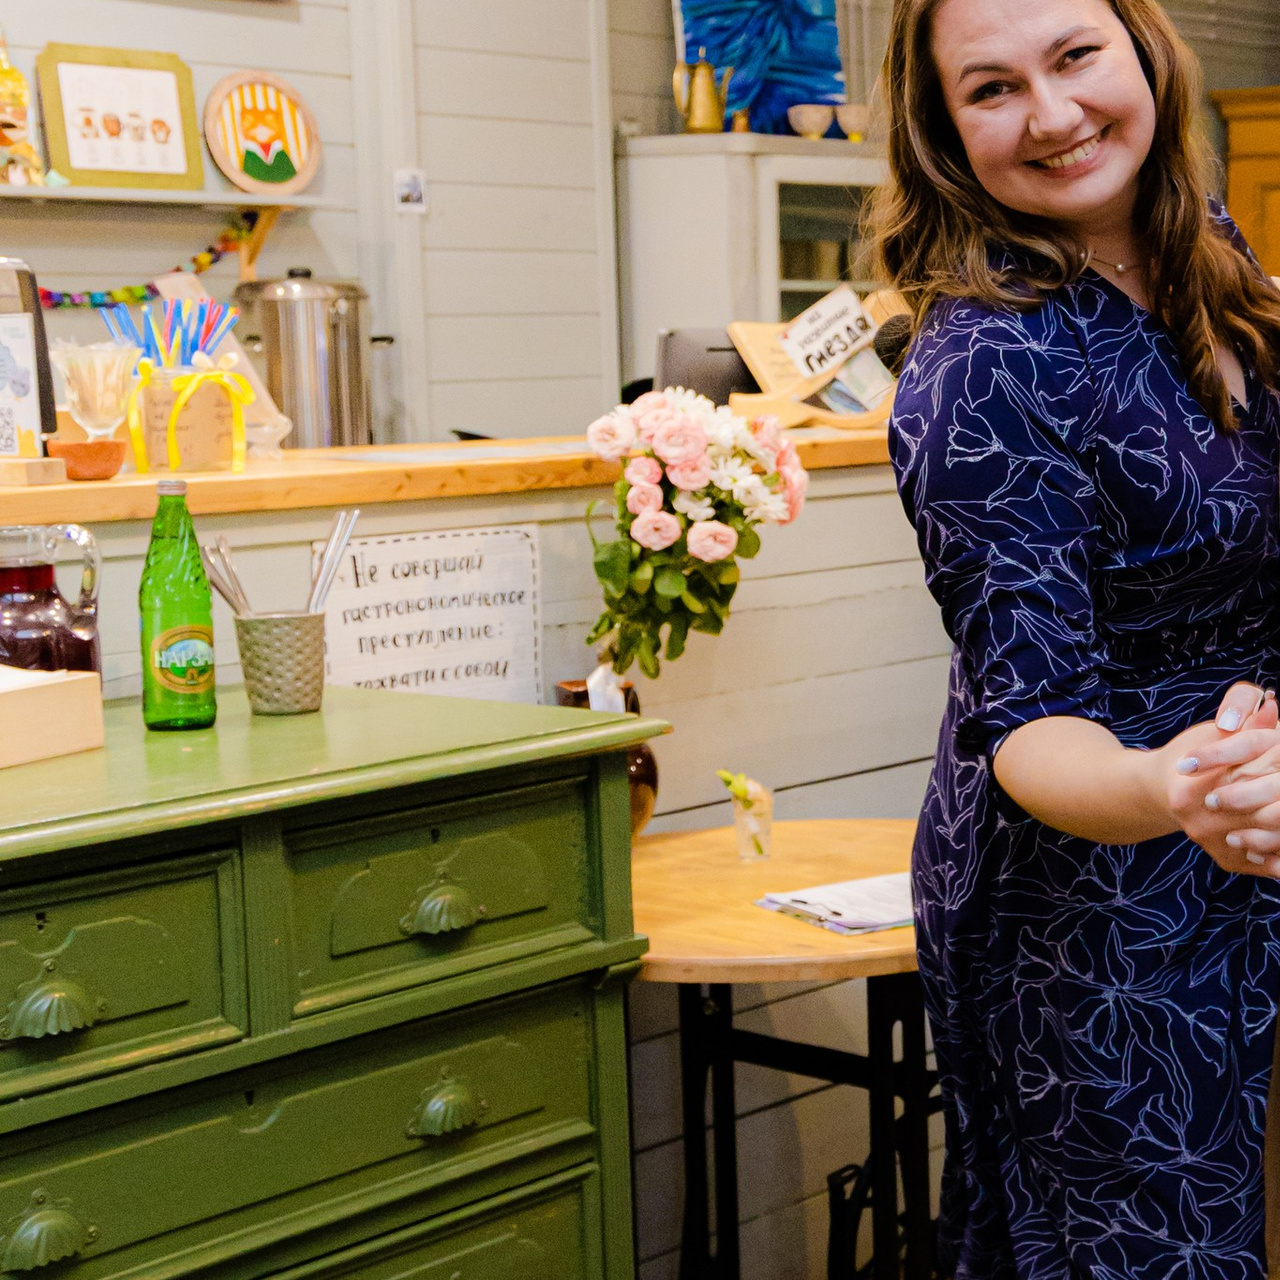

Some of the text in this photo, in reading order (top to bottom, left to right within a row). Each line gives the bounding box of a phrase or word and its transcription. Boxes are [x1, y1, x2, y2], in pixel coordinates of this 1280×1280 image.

[352, 549, 483, 588] Не совершай
[154, 650, 213, 667] НАРЗА
